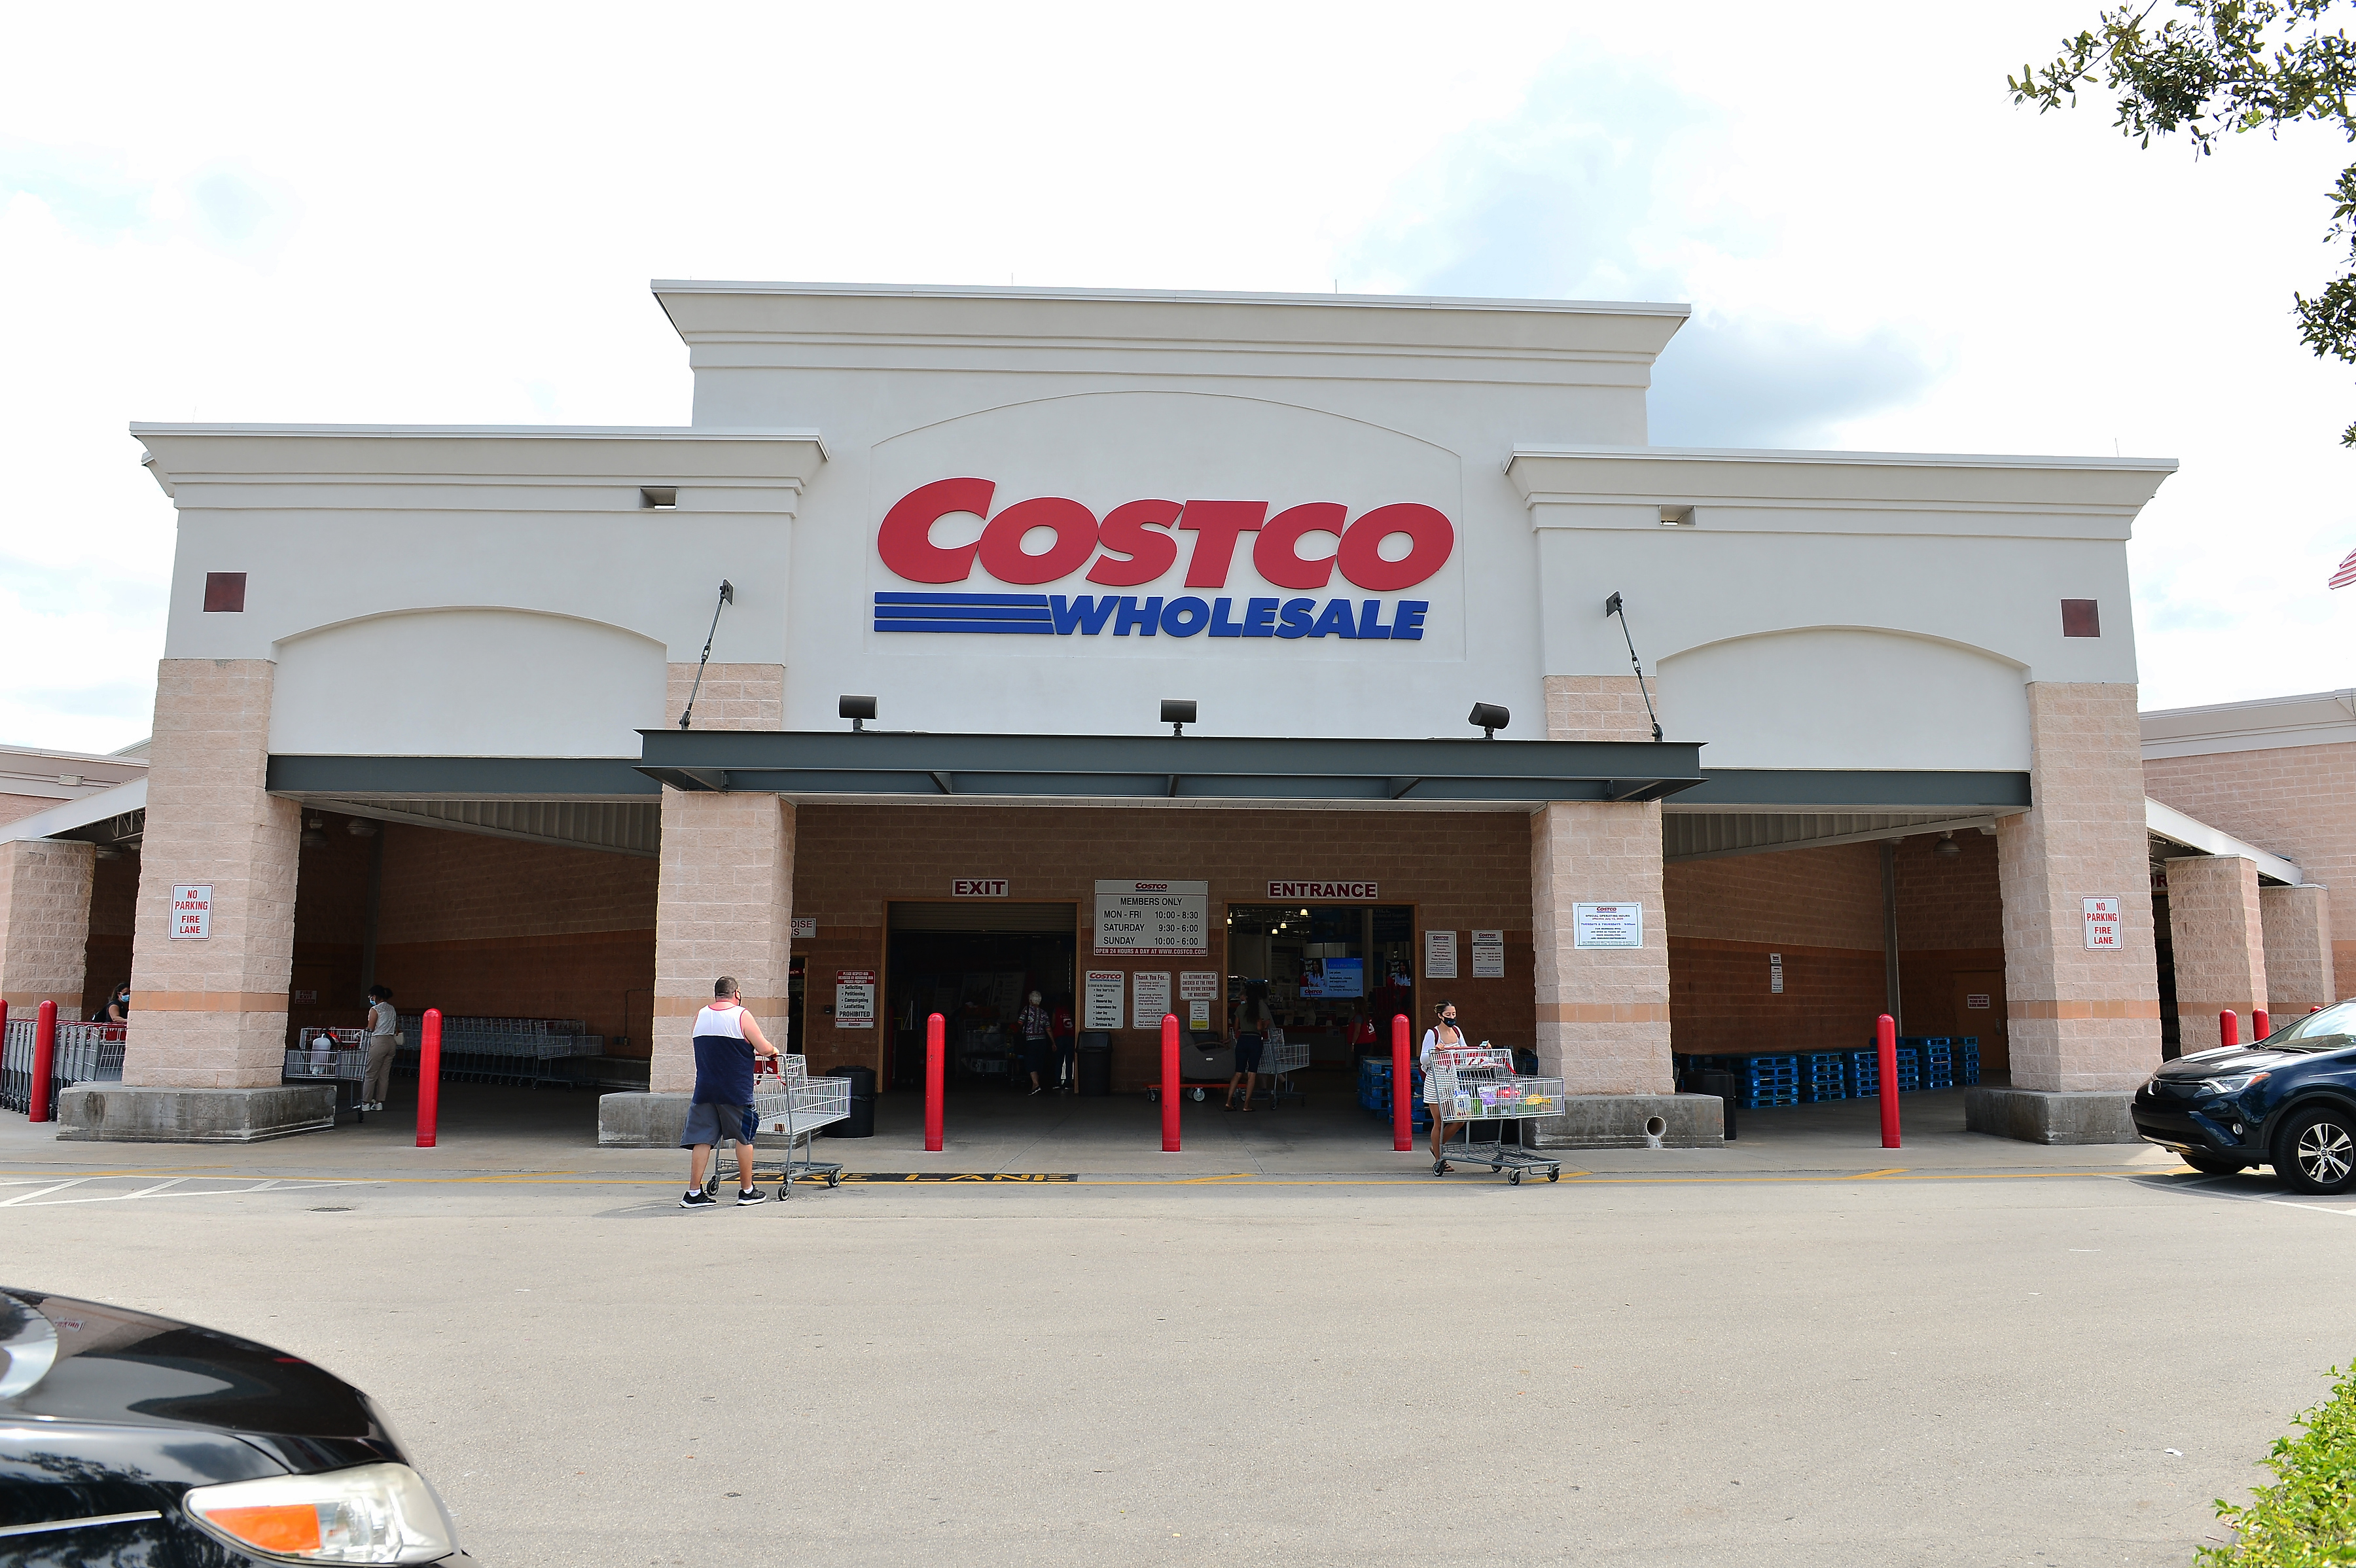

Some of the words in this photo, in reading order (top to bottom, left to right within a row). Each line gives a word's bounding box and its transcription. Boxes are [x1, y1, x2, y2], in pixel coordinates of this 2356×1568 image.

[876, 476, 1455, 592] COSTCO
[1048, 594, 1429, 640] WHOLESALE
[955, 881, 1006, 895] EXIT
[1270, 883, 1377, 897] ENTRANCE
[187, 890, 198, 899] NO
[175, 901, 208, 910] PARKING
[1120, 897, 1160, 906] MEMBERS
[2096, 902, 2105, 911] NO
[1130, 910, 1142, 919] FRI
[2086, 913, 2117, 921] PARKING
